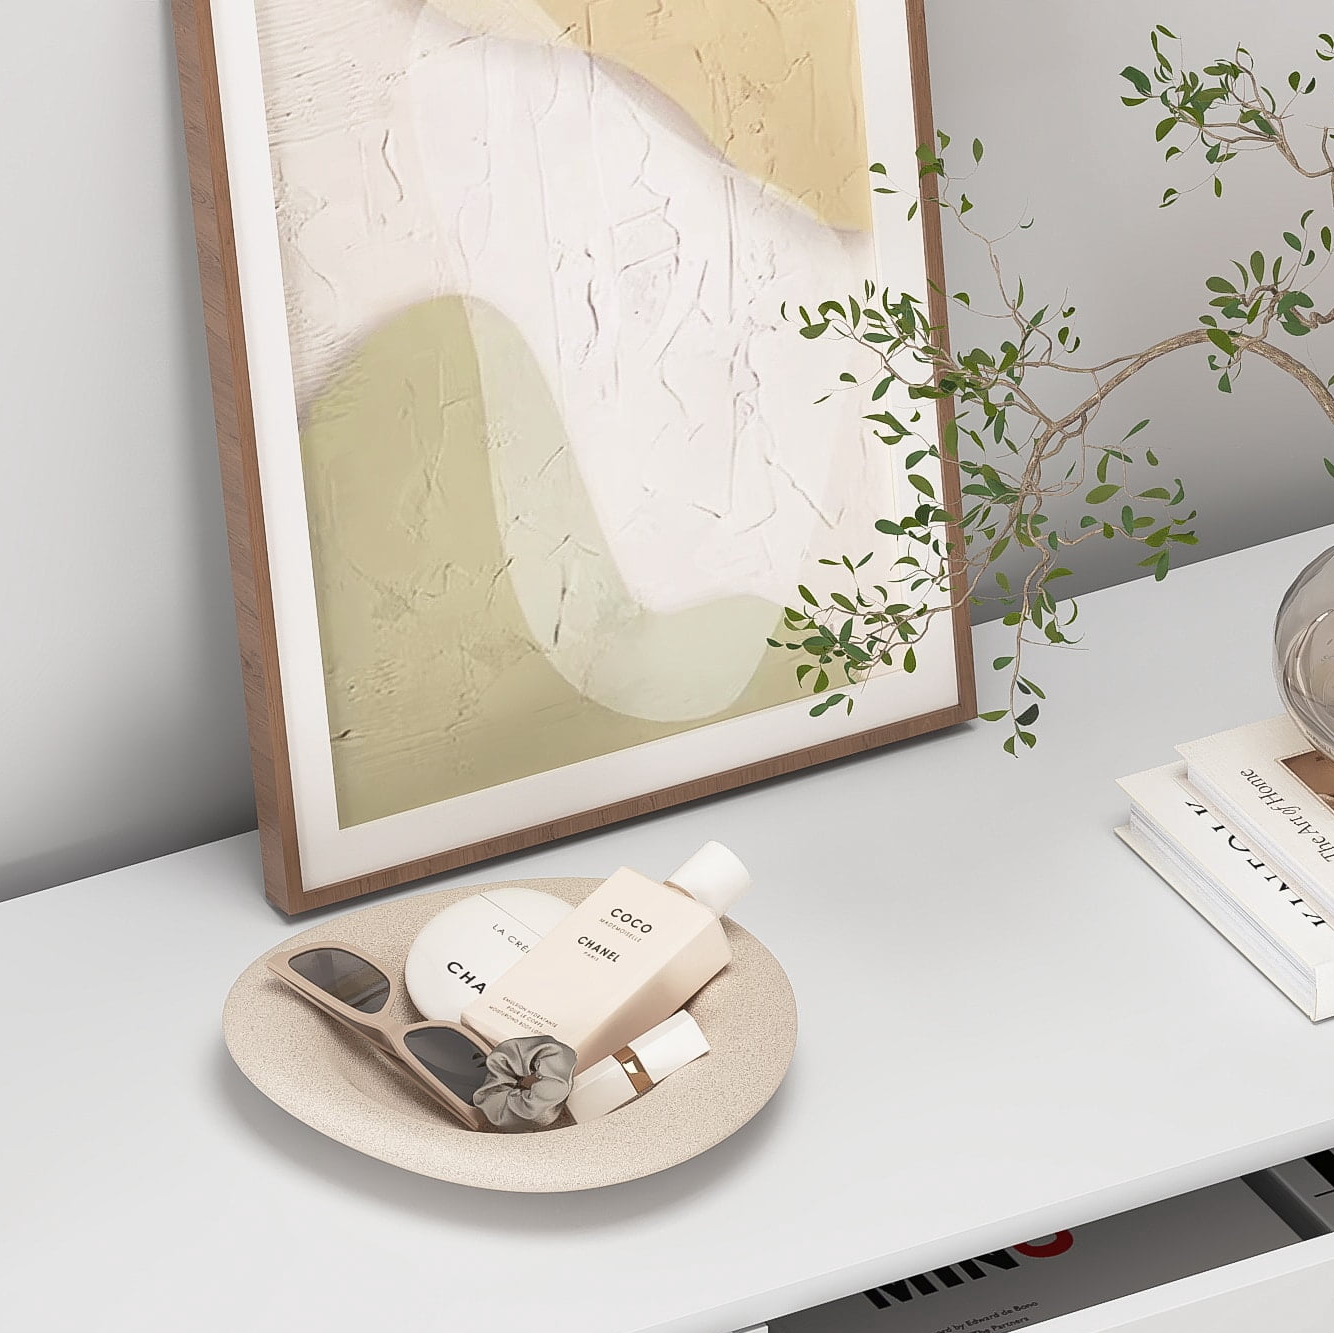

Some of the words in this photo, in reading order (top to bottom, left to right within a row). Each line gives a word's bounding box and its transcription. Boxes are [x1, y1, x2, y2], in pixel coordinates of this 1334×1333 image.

[1240, 768, 1285, 806] Home
[1270, 802, 1297, 816] of
[1289, 817, 1319, 834] Art
[491, 923, 505, 937] LA
[598, 917, 643, 943] MADEMOISELLE
[610, 908, 653, 934] COCO
[577, 936, 621, 963] CHANEL
[952, 1323, 966, 1332] by
[965, 1312, 1000, 1327] Edward
[1013, 1301, 1039, 1312] Bono
[991, 1316, 1030, 1332] Partners
